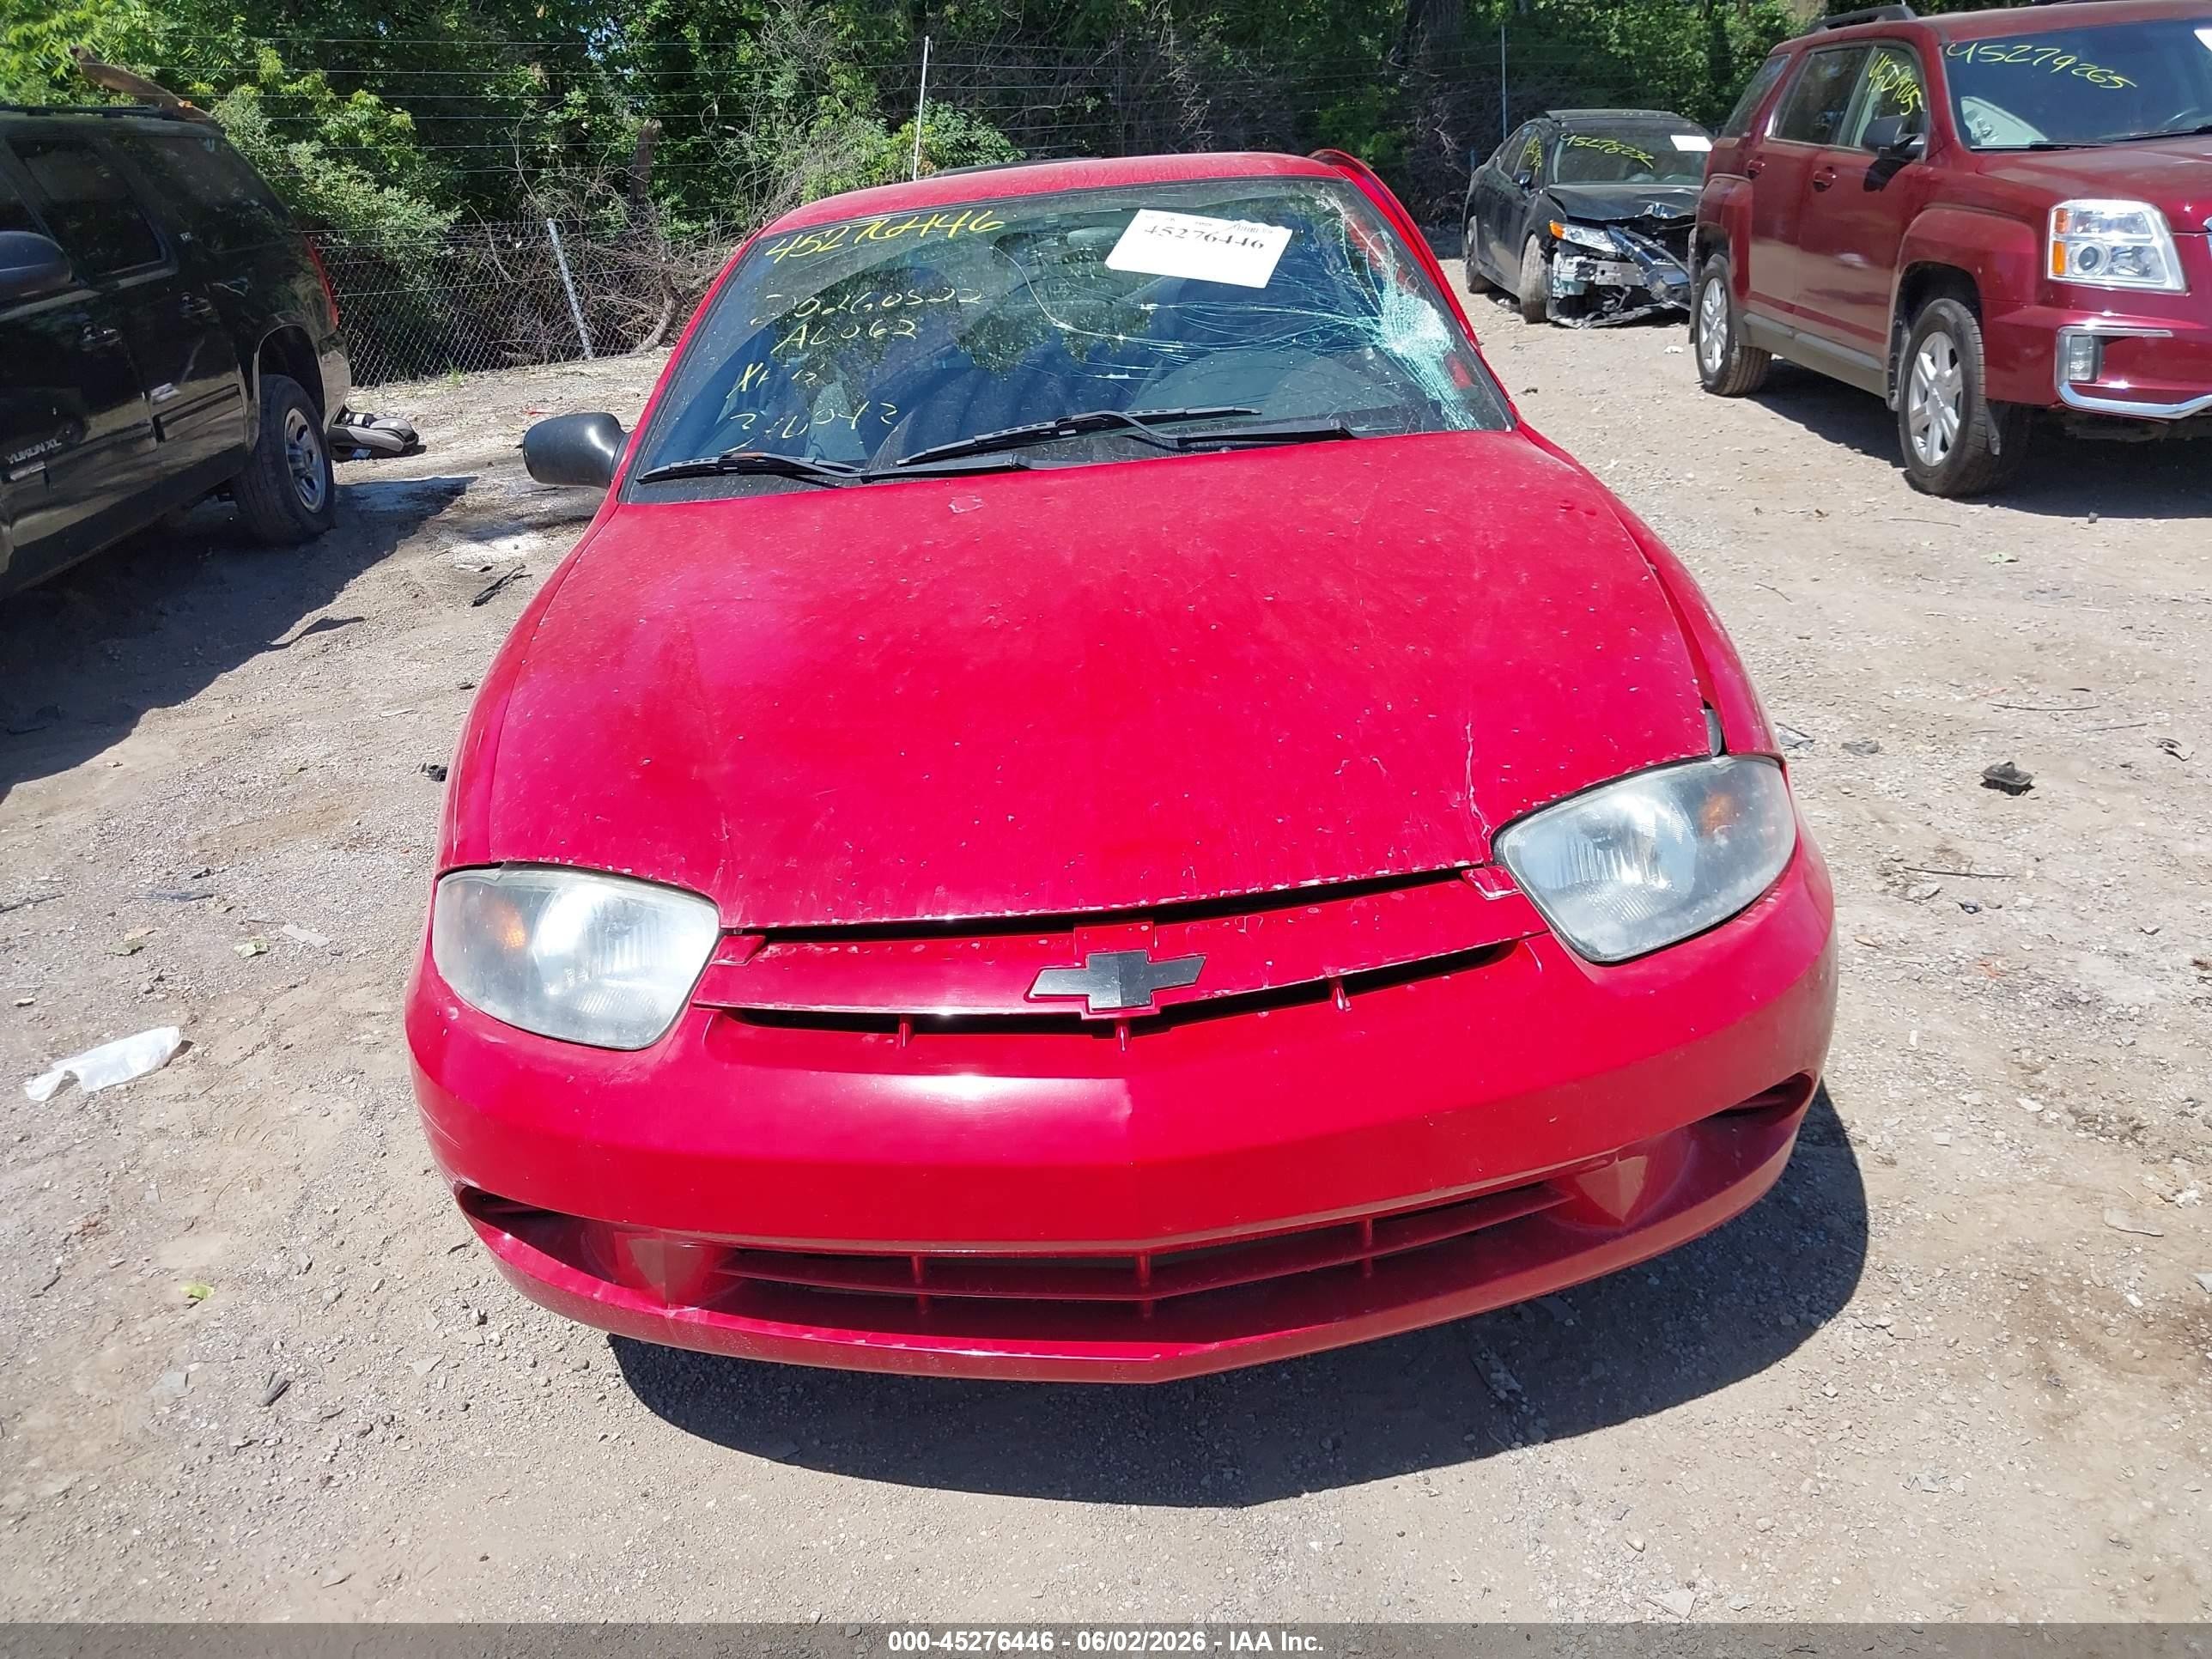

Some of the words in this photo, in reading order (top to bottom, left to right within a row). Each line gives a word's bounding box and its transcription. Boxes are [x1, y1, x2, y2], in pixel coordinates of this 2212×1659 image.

[1946, 41, 2137, 88] 45279265
[765, 210, 1006, 264] 45276446
[1144, 225, 1264, 250] 45276446
